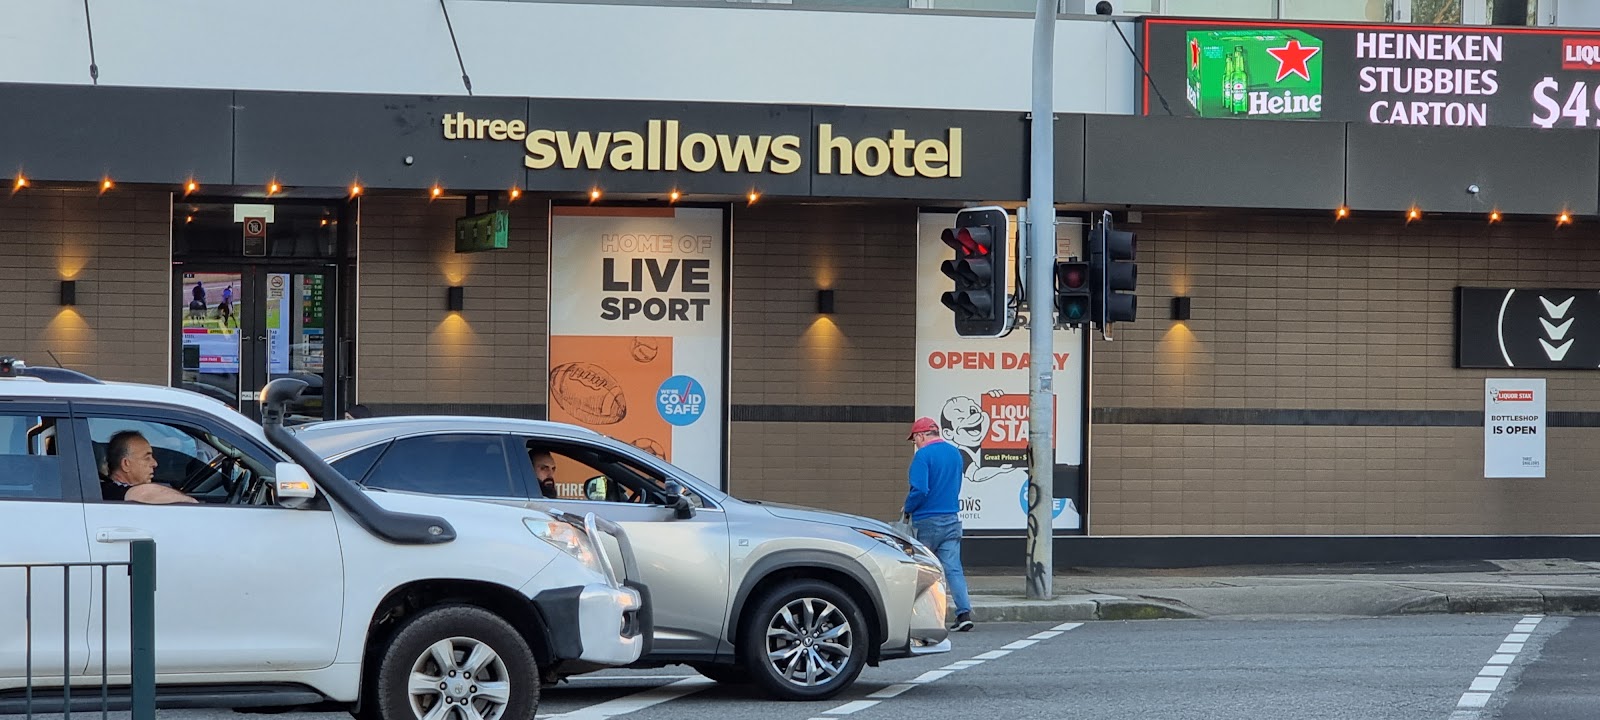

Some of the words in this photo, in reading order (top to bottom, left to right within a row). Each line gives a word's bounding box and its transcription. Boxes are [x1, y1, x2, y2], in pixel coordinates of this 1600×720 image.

[1356, 32, 1503, 62] HEINEKEN
[1359, 66, 1498, 95] STUBBIES
[1248, 90, 1322, 115] Heine
[1369, 100, 1487, 126] CARTON
[1532, 76, 1600, 129] $4
[442, 112, 526, 141] three
[524, 119, 802, 174] swallows
[817, 123, 963, 178] hotel
[601, 233, 673, 253] HOME
[678, 234, 712, 254] OF
[602, 257, 711, 293] LIVE
[600, 297, 711, 321] SPORT
[928, 351, 995, 370] OPEN
[1001, 352, 1069, 371] DAY
[660, 391, 702, 405] COVID
[665, 404, 699, 415] SAFE
[990, 404, 1030, 422] LIQU
[1493, 426, 1503, 435] IS
[1506, 426, 1537, 435] OPEN
